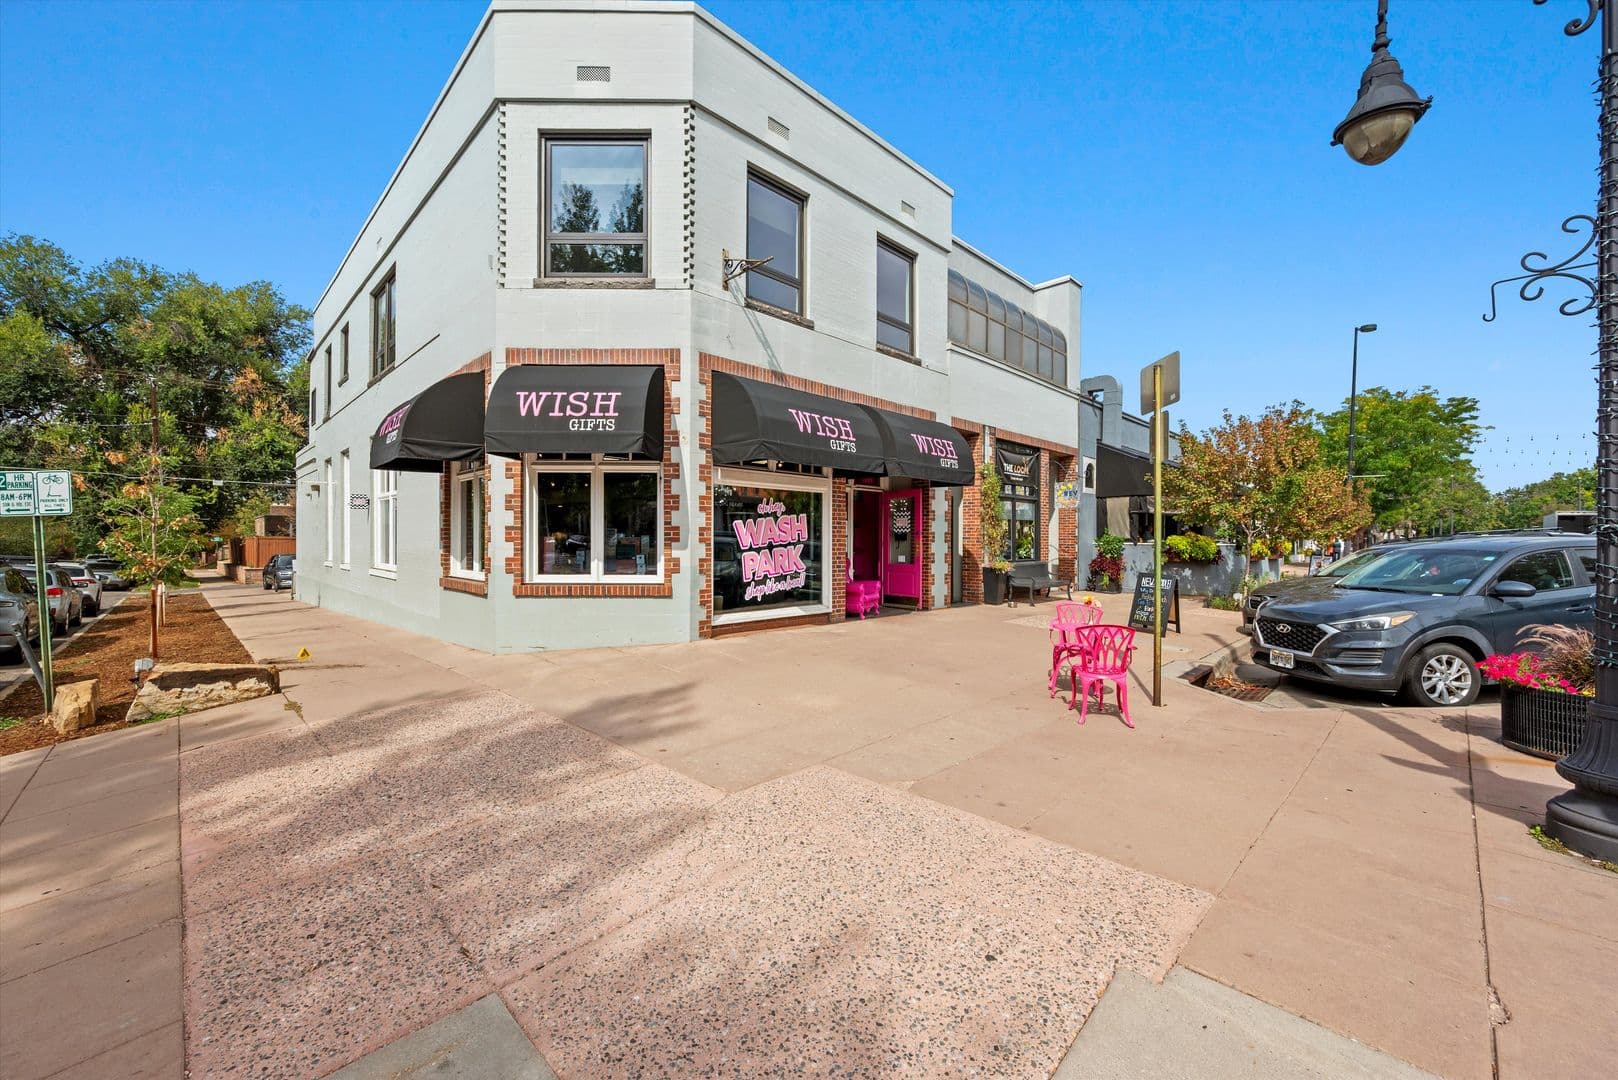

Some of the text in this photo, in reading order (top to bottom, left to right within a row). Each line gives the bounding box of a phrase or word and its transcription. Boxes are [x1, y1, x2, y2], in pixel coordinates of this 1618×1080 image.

[516, 391, 622, 417] WISH
[569, 418, 616, 431] GIFTS
[788, 408, 857, 441] WISH
[830, 439, 857, 453] GIFTS
[911, 433, 959, 459] WISH
[940, 457, 959, 469] GIFTS
[1003, 463, 1013, 474] THE
[0, 473, 25, 488] 2 HR
[733, 513, 808, 549] WASH
[742, 544, 806, 582] PARK
[745, 581, 767, 601] shop
